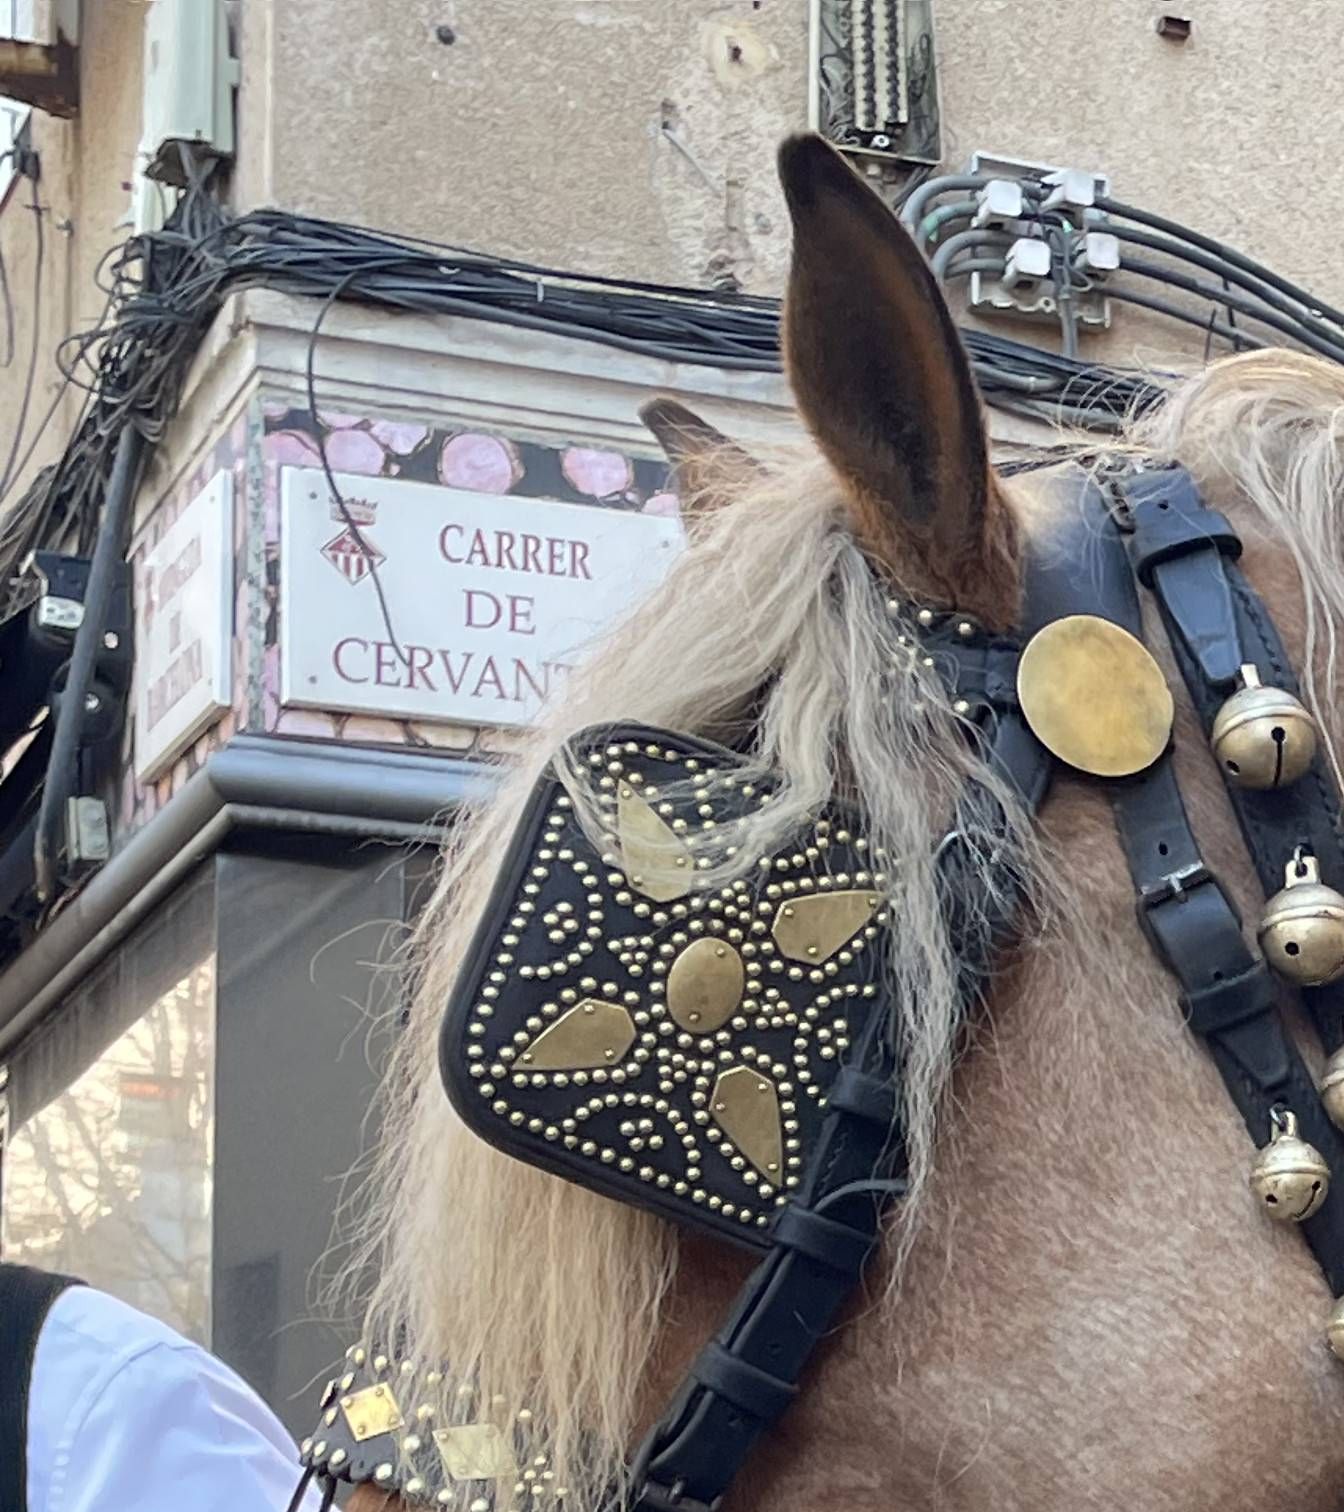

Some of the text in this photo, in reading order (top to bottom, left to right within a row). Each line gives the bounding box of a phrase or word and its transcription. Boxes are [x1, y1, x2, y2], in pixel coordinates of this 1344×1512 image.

[439, 524, 593, 581] CARRER
[462, 588, 537, 635] DE
[331, 637, 582, 704] CERVANT
